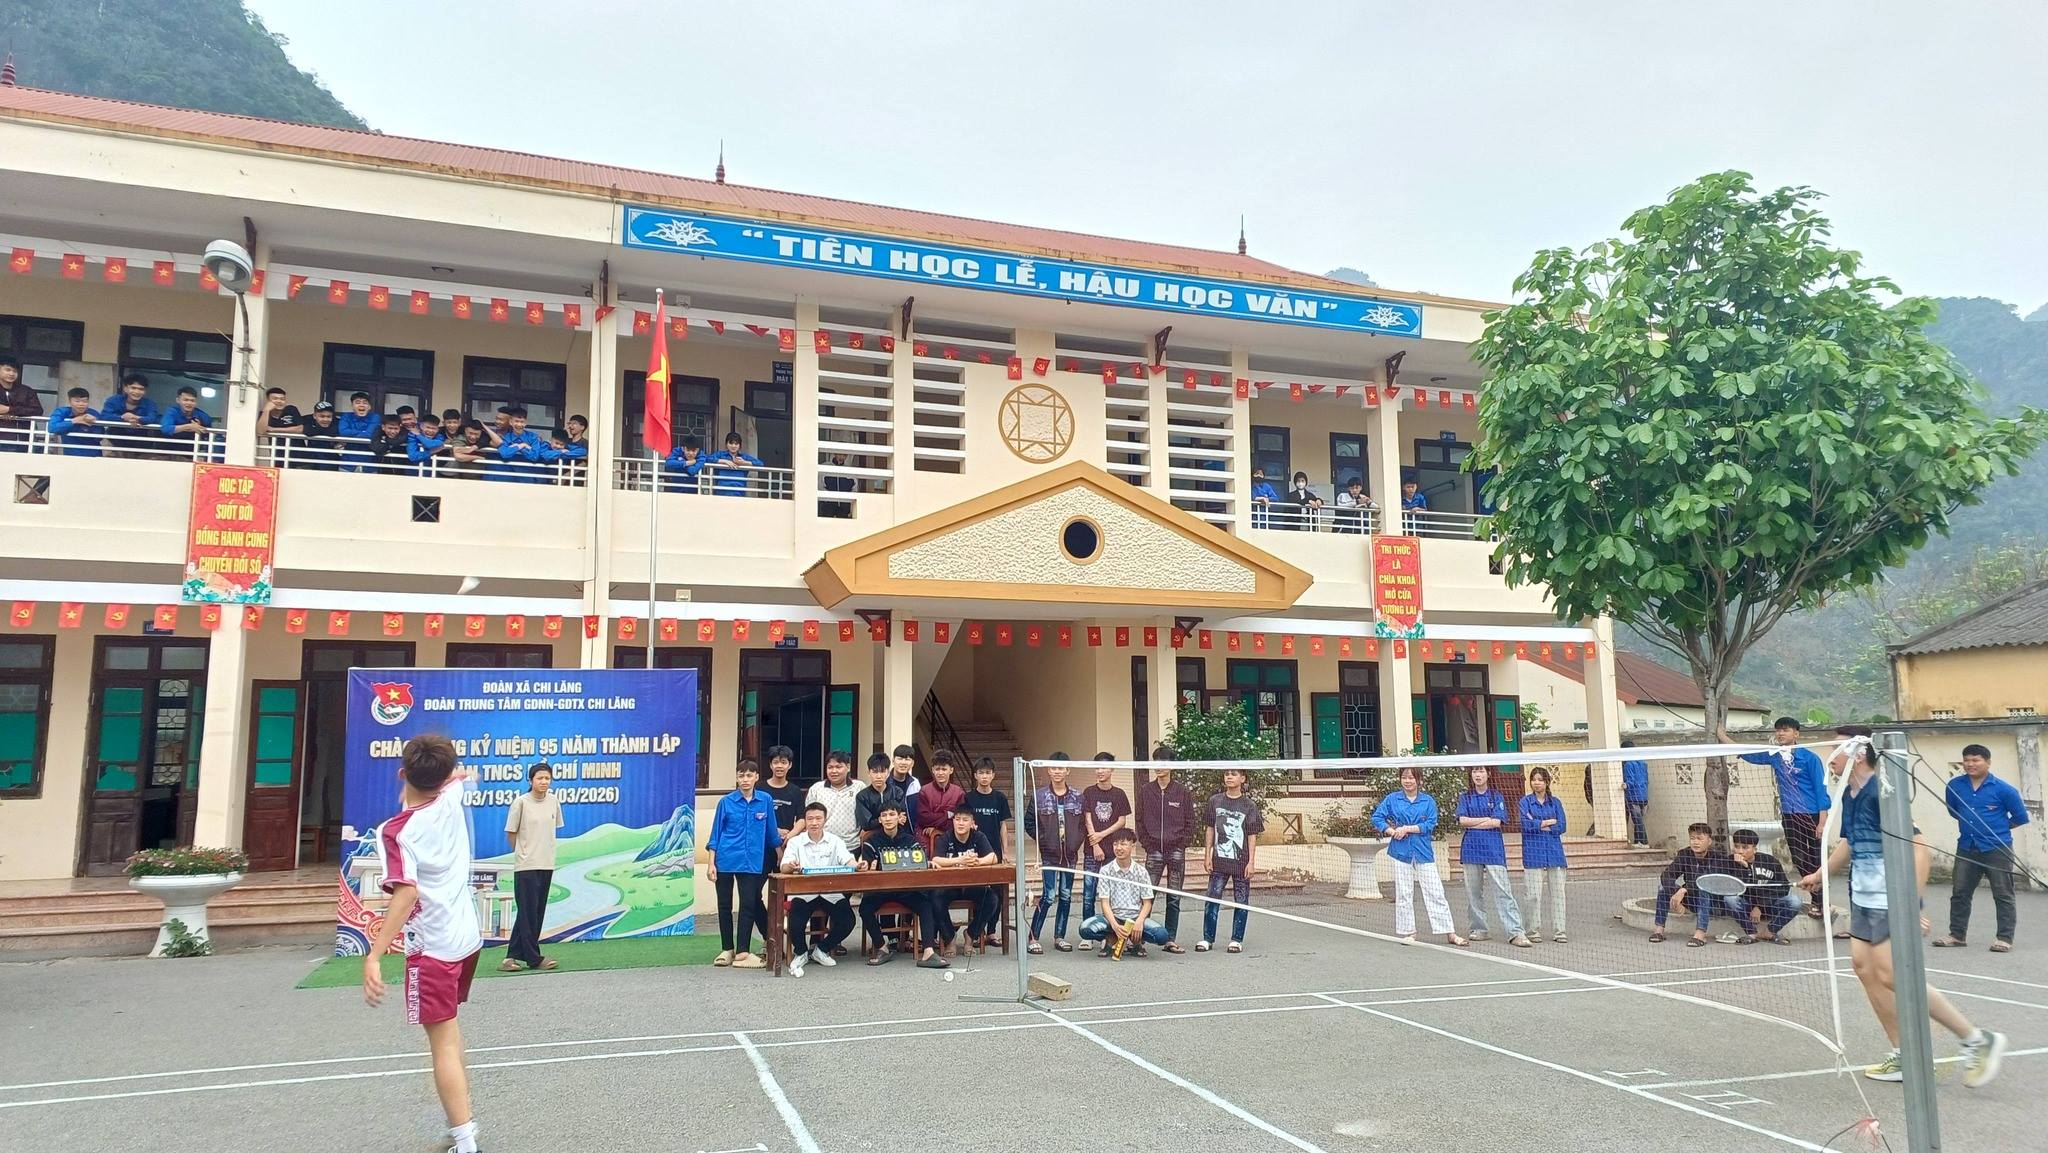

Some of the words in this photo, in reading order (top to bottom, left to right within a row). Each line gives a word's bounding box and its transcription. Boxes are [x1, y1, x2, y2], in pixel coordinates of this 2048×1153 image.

[890, 249, 980, 279] HỌC
[996, 258, 1048, 290] LỄ,
[1060, 270, 1140, 298] HẬU
[1154, 282, 1233, 309] HỌC
[218, 477, 237, 497] HỌC
[238, 475, 254, 498] TẬP
[215, 499, 238, 521] SUỐT
[238, 501, 253, 521] ĐỜI
[195, 525, 219, 546] ĐỒNG
[220, 527, 245, 547] HÀNH
[245, 529, 269, 548] CÙNG
[1380, 545, 1391, 555] TRI
[1393, 543, 1412, 556] THỨC
[199, 551, 233, 573] CHUYỂN
[233, 552, 249, 574] ĐỔI
[249, 553, 262, 574] SỐ
[1392, 558, 1402, 570] LÀ
[1379, 573, 1396, 585] CHÌA
[1384, 587, 1397, 600] MỞ
[1398, 587, 1412, 600] CỬA
[1381, 604, 1404, 615] TƯƠNG
[1405, 605, 1417, 615] LAI
[483, 680, 513, 693] ĐOÀN
[516, 680, 530, 693] XÃ
[533, 682, 550, 693] CHI
[554, 680, 582, 693] LĂNG
[424, 697, 455, 711] ĐOÀN
[458, 699, 494, 711] TRUNG
[497, 697, 521, 710] TÂM
[524, 699, 585, 710] GDNN-GDTX
[588, 698, 605, 710] CHI
[608, 696, 635, 710] LĂNG
[370, 736, 410, 758] CHÀ
[471, 733, 492, 756] KỶ
[495, 735, 535, 758] NIỆM
[539, 738, 558, 755] 95
[562, 735, 597, 755] NĂM
[601, 734, 650, 754] THÀNH
[653, 733, 681, 756] LẬP
[482, 763, 523, 781] TNCS
[553, 759, 578, 779] CHÍ
[582, 762, 622, 779] MINH
[883, 850, 897, 864] 16
[912, 850, 923, 863] 9
